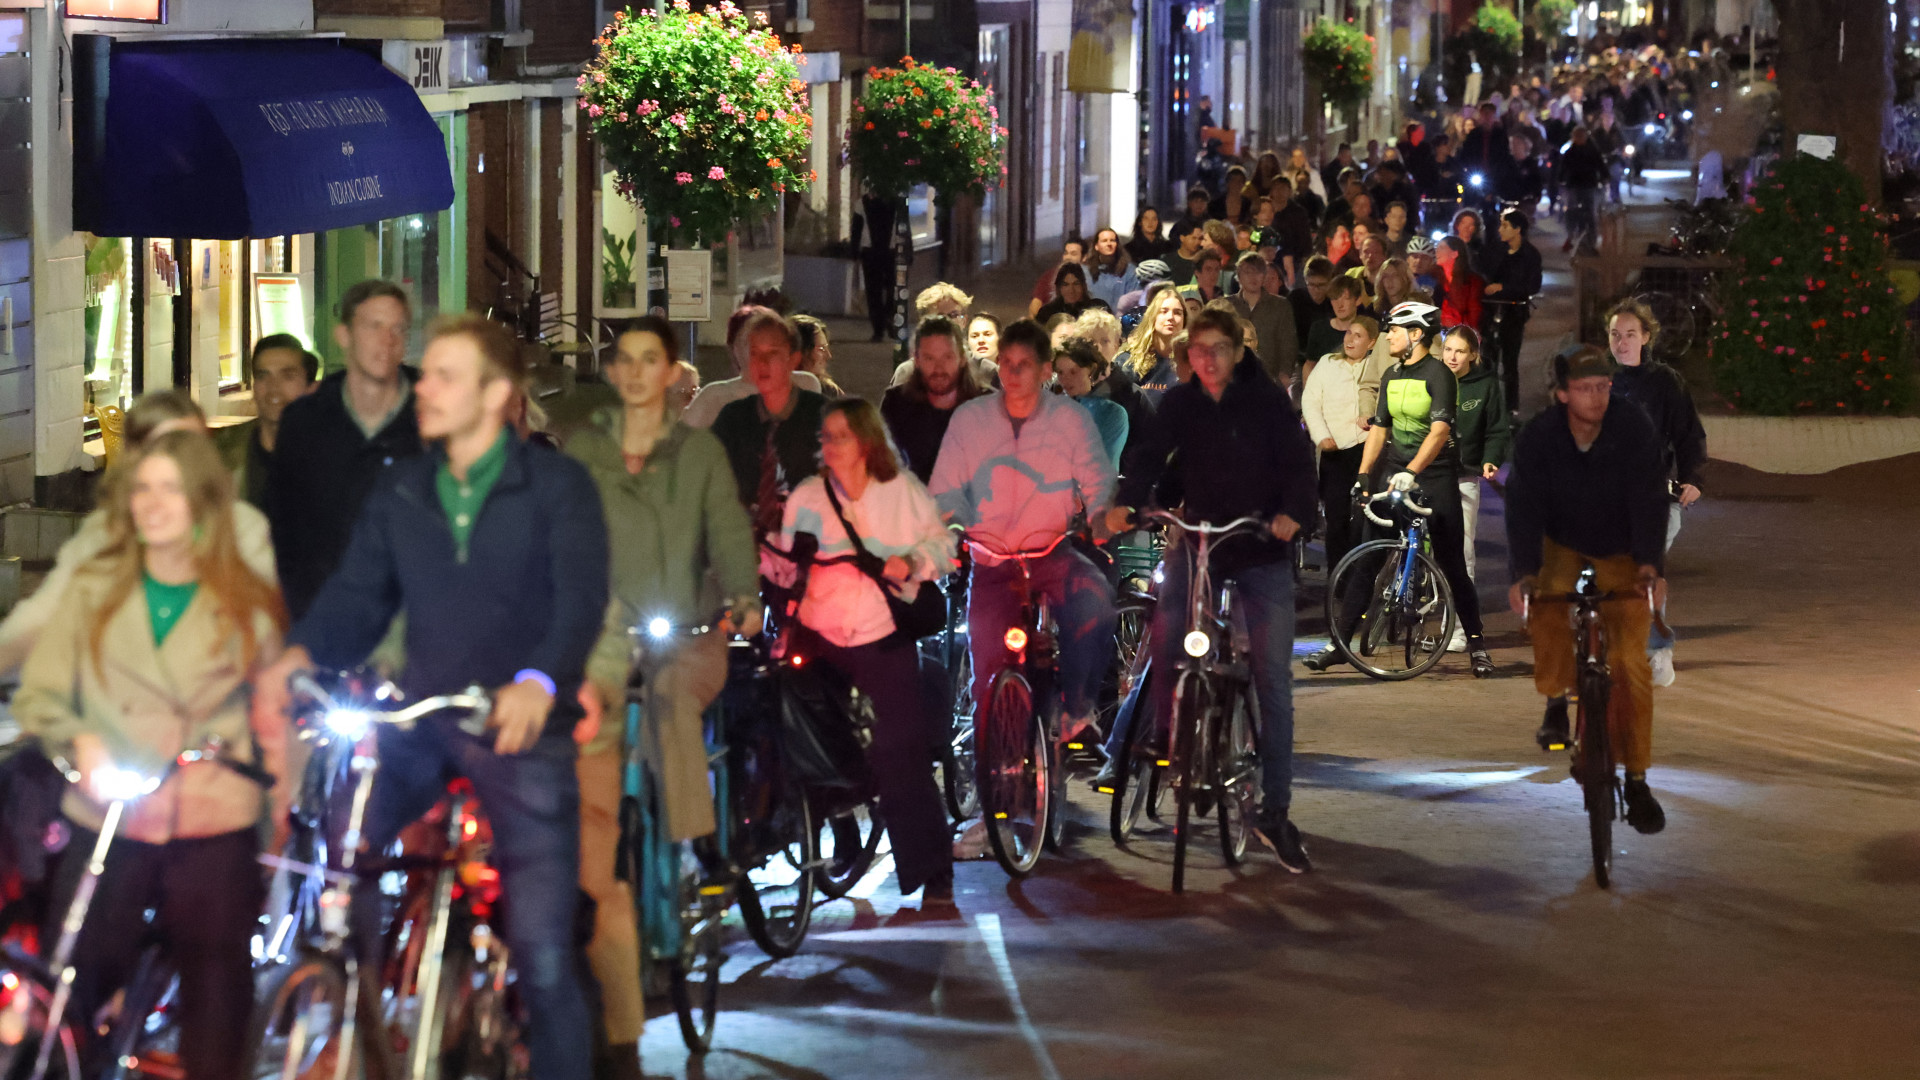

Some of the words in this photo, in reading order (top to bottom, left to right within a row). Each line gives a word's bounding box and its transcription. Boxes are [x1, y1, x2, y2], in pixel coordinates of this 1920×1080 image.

[259, 101, 336, 136] RESTAURANT
[327, 179, 356, 206] INDIAN
[354, 175, 383, 201] CUISINE
